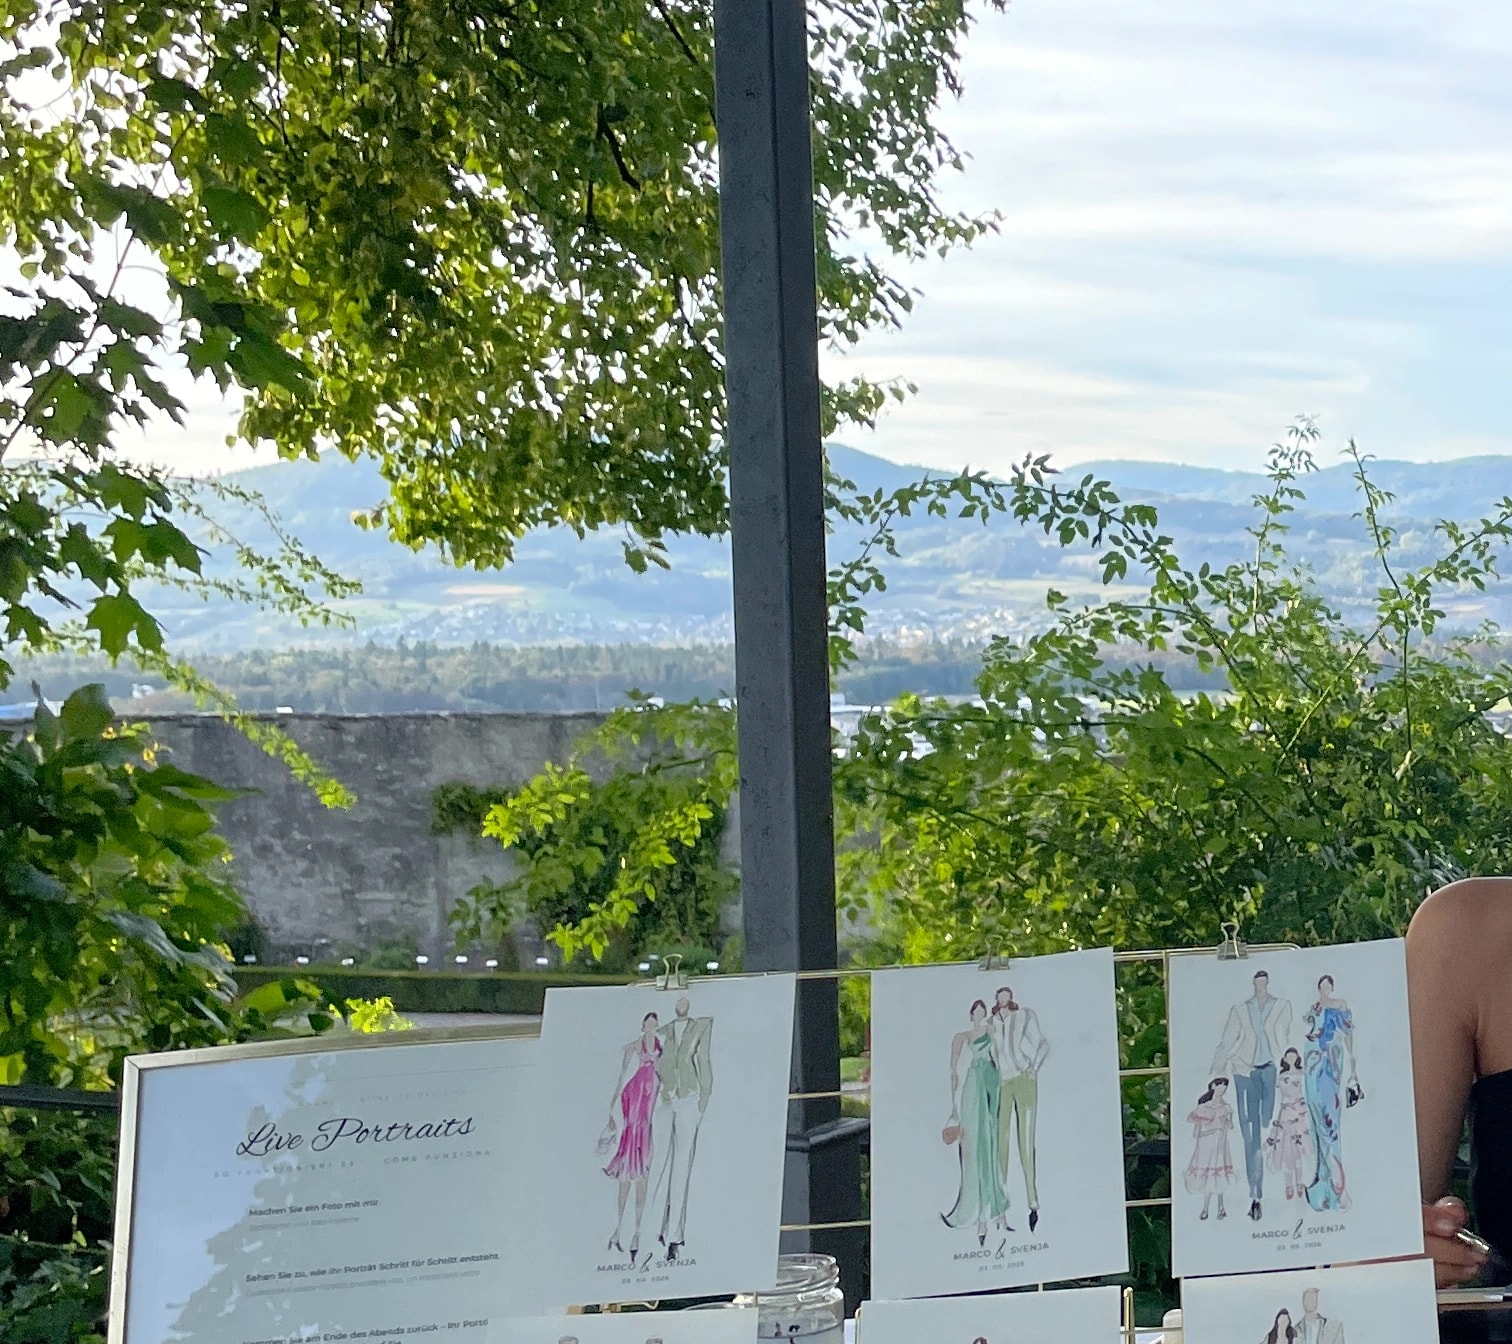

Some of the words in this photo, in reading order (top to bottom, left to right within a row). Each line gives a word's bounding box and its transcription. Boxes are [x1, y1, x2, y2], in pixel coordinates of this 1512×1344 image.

[236, 1121, 304, 1157] Live
[311, 1116, 477, 1152] Portraits
[248, 1207, 286, 1216] Machen
[288, 1205, 303, 1213] Sie
[304, 1204, 319, 1212] ein
[321, 1202, 343, 1210] Foto
[343, 1200, 360, 1208] mit
[1252, 1229, 1289, 1239] MARCO
[1292, 1218, 1303, 1240] &
[1307, 1223, 1346, 1235] SVENJA
[953, 1249, 991, 1260] MARCO
[995, 1238, 1007, 1260] &
[1010, 1242, 1049, 1254] SVENJA
[245, 1273, 276, 1282] Sehen
[277, 1271, 292, 1279] Sie
[378, 1260, 409, 1270] Schritt
[410, 1259, 425, 1267] für
[426, 1256, 457, 1266] Schritt
[597, 1263, 636, 1272] MARCO
[640, 1252, 653, 1274] &
[656, 1258, 697, 1268] SVENJA
[288, 1337, 303, 1344] Sie
[305, 1335, 320, 1343] am
[322, 1332, 347, 1341] Ende
[349, 1330, 367, 1339] des
[406, 1323, 438, 1334] zurück
